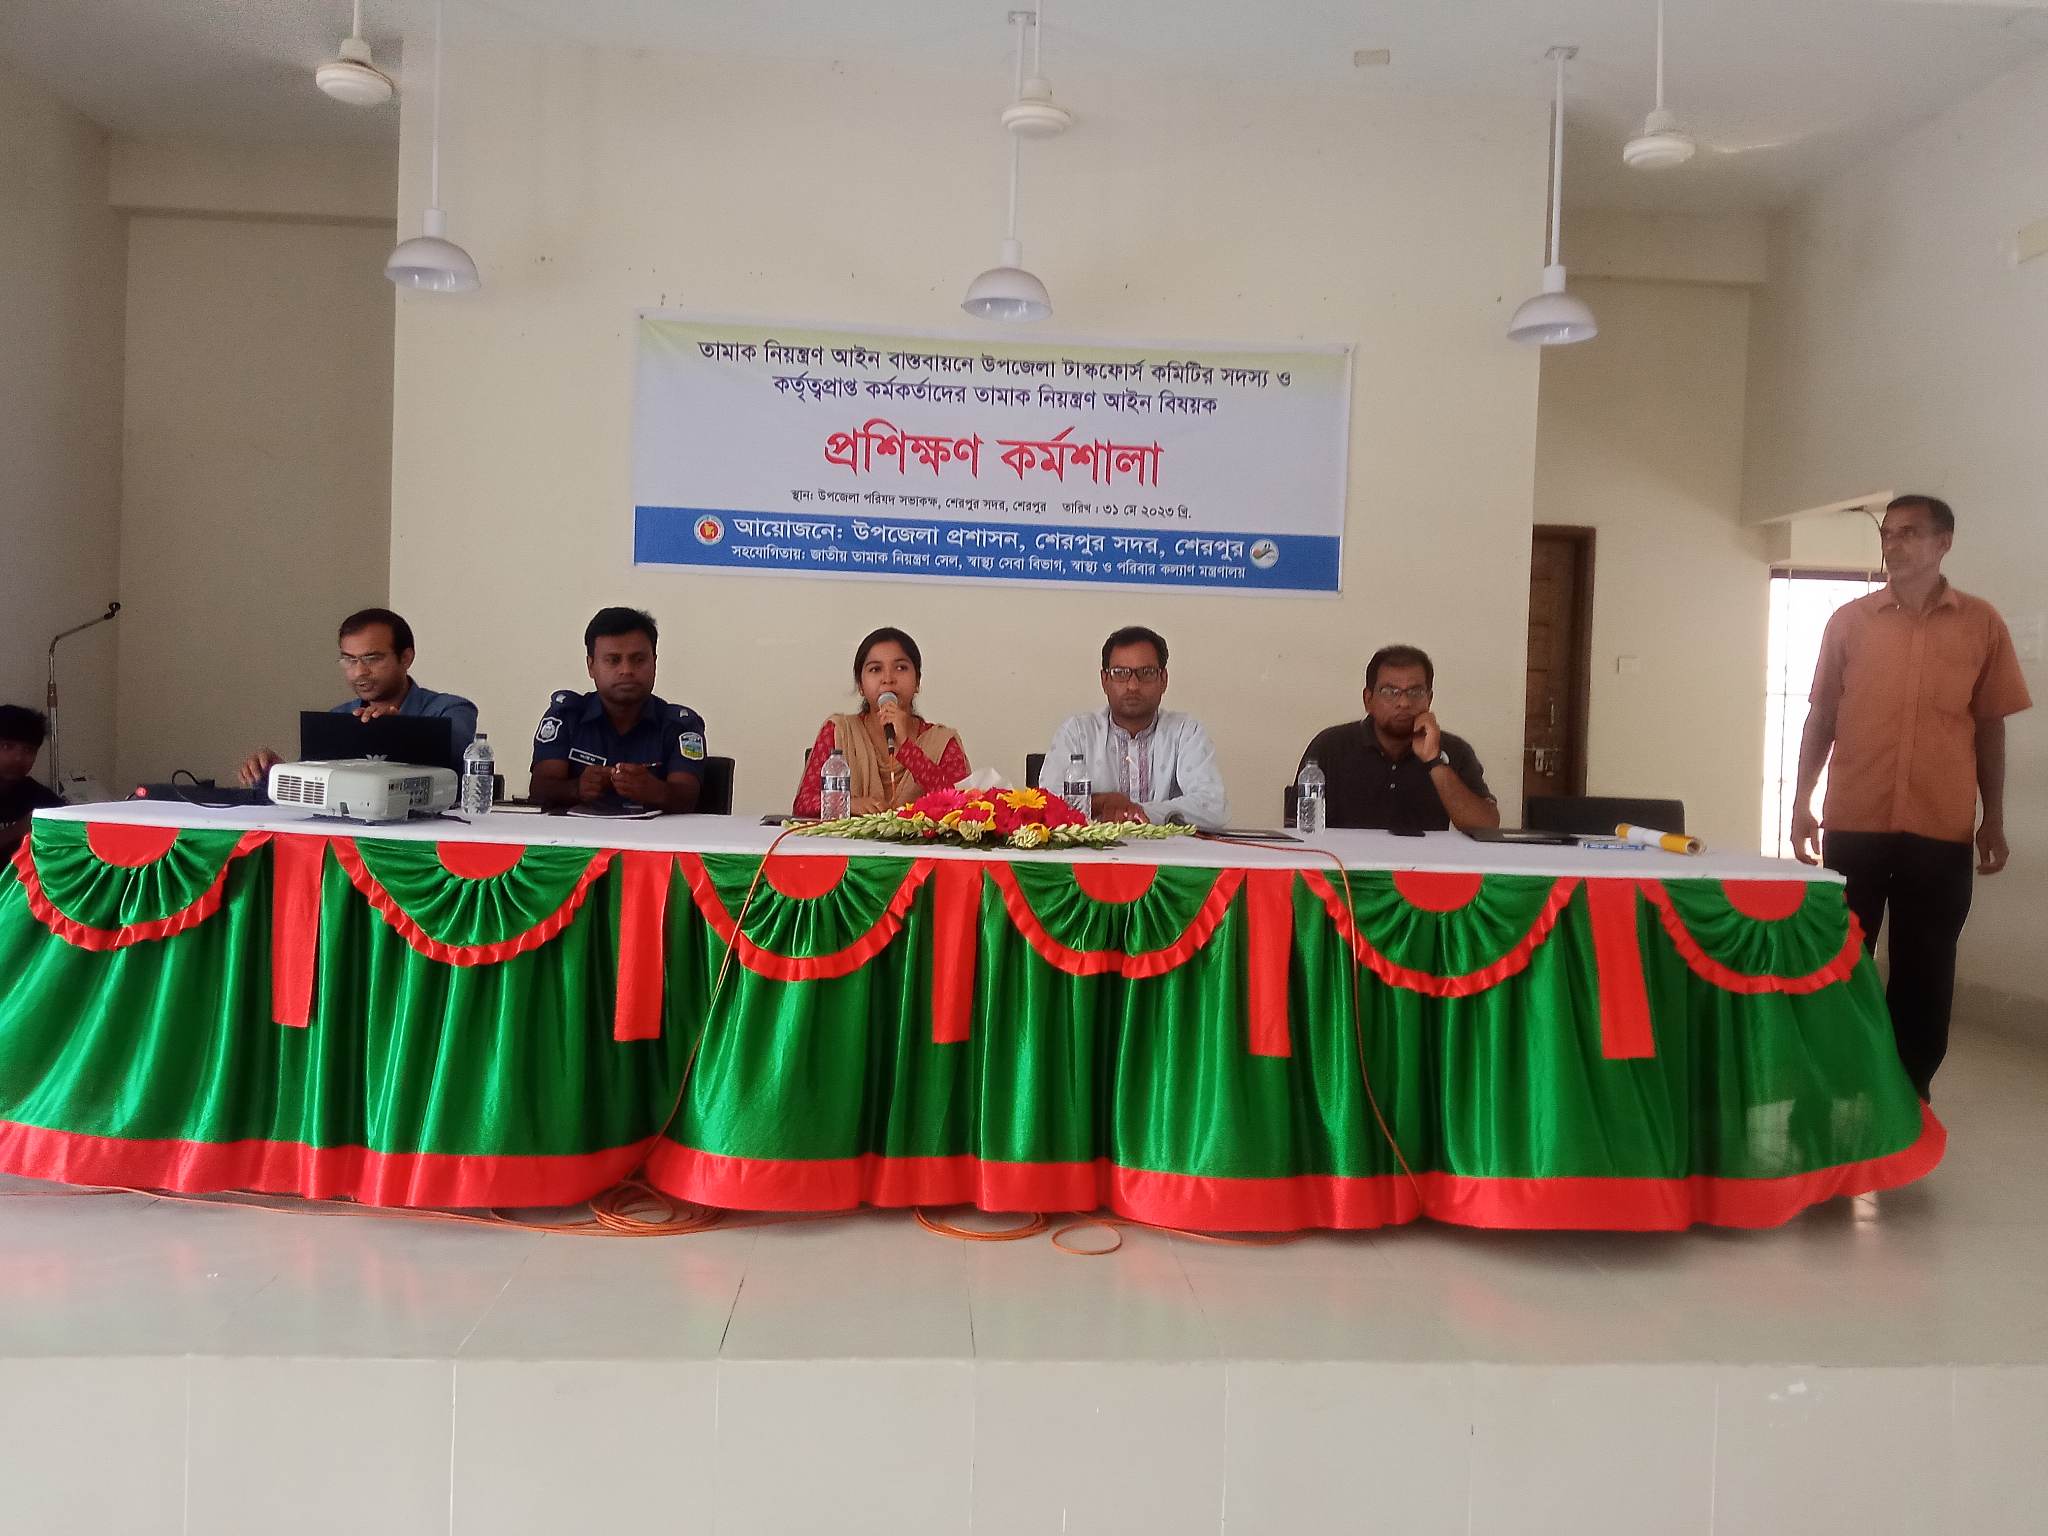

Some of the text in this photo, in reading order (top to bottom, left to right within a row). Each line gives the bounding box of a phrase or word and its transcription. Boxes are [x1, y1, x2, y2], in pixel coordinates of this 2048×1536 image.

[697, 338, 1291, 389] তামাক নিয়ন্ত্রণ আইন বাস্তবায়নে উপজেলা টাস্কফোর্স কমিটির সদস্য ও
[864, 376, 966, 403] কর্মকর্তাদের
[974, 384, 1031, 407] তামাক
[1038, 383, 1097, 410] নিয়ন্ত্রণ
[1103, 387, 1152, 414] আইন
[1158, 388, 1217, 416] বিষয়ক
[824, 417, 1165, 488] প্রশিক্ষণ কর্মশালা
[818, 488, 860, 504] উপজেলা
[864, 490, 896, 506] পরিষদ
[945, 497, 979, 512] শেরপুর
[983, 498, 1009, 512] সদর,
[1013, 500, 1047, 514] শেরপুর
[1062, 500, 1092, 514] তারিখ
[1102, 503, 1119, 516] ৩১
[1124, 503, 1137, 517] মে
[1141, 505, 1175, 519] ২০২৩
[852, 519, 939, 546] উপজেলা
[946, 526, 1025, 553] প্রশাসন,
[1035, 532, 1106, 556] শেরপুর
[1112, 535, 1165, 560] সদর,
[1175, 537, 1245, 561] শেরপুর
[810, 545, 848, 563] জাতীয়
[852, 549, 888, 565] তামাক
[892, 548, 930, 567] নিয়ন্ত্রণ
[935, 553, 963, 570] সেল,
[999, 555, 1025, 571] সেবা
[1029, 555, 1066, 574] বিভাগ,
[1102, 561, 1112, 574] ও
[1116, 558, 1156, 577] পরিবার
[1161, 563, 1195, 578] কল্যাণ
[1199, 565, 1246, 580] মন্ত্রণালয়
